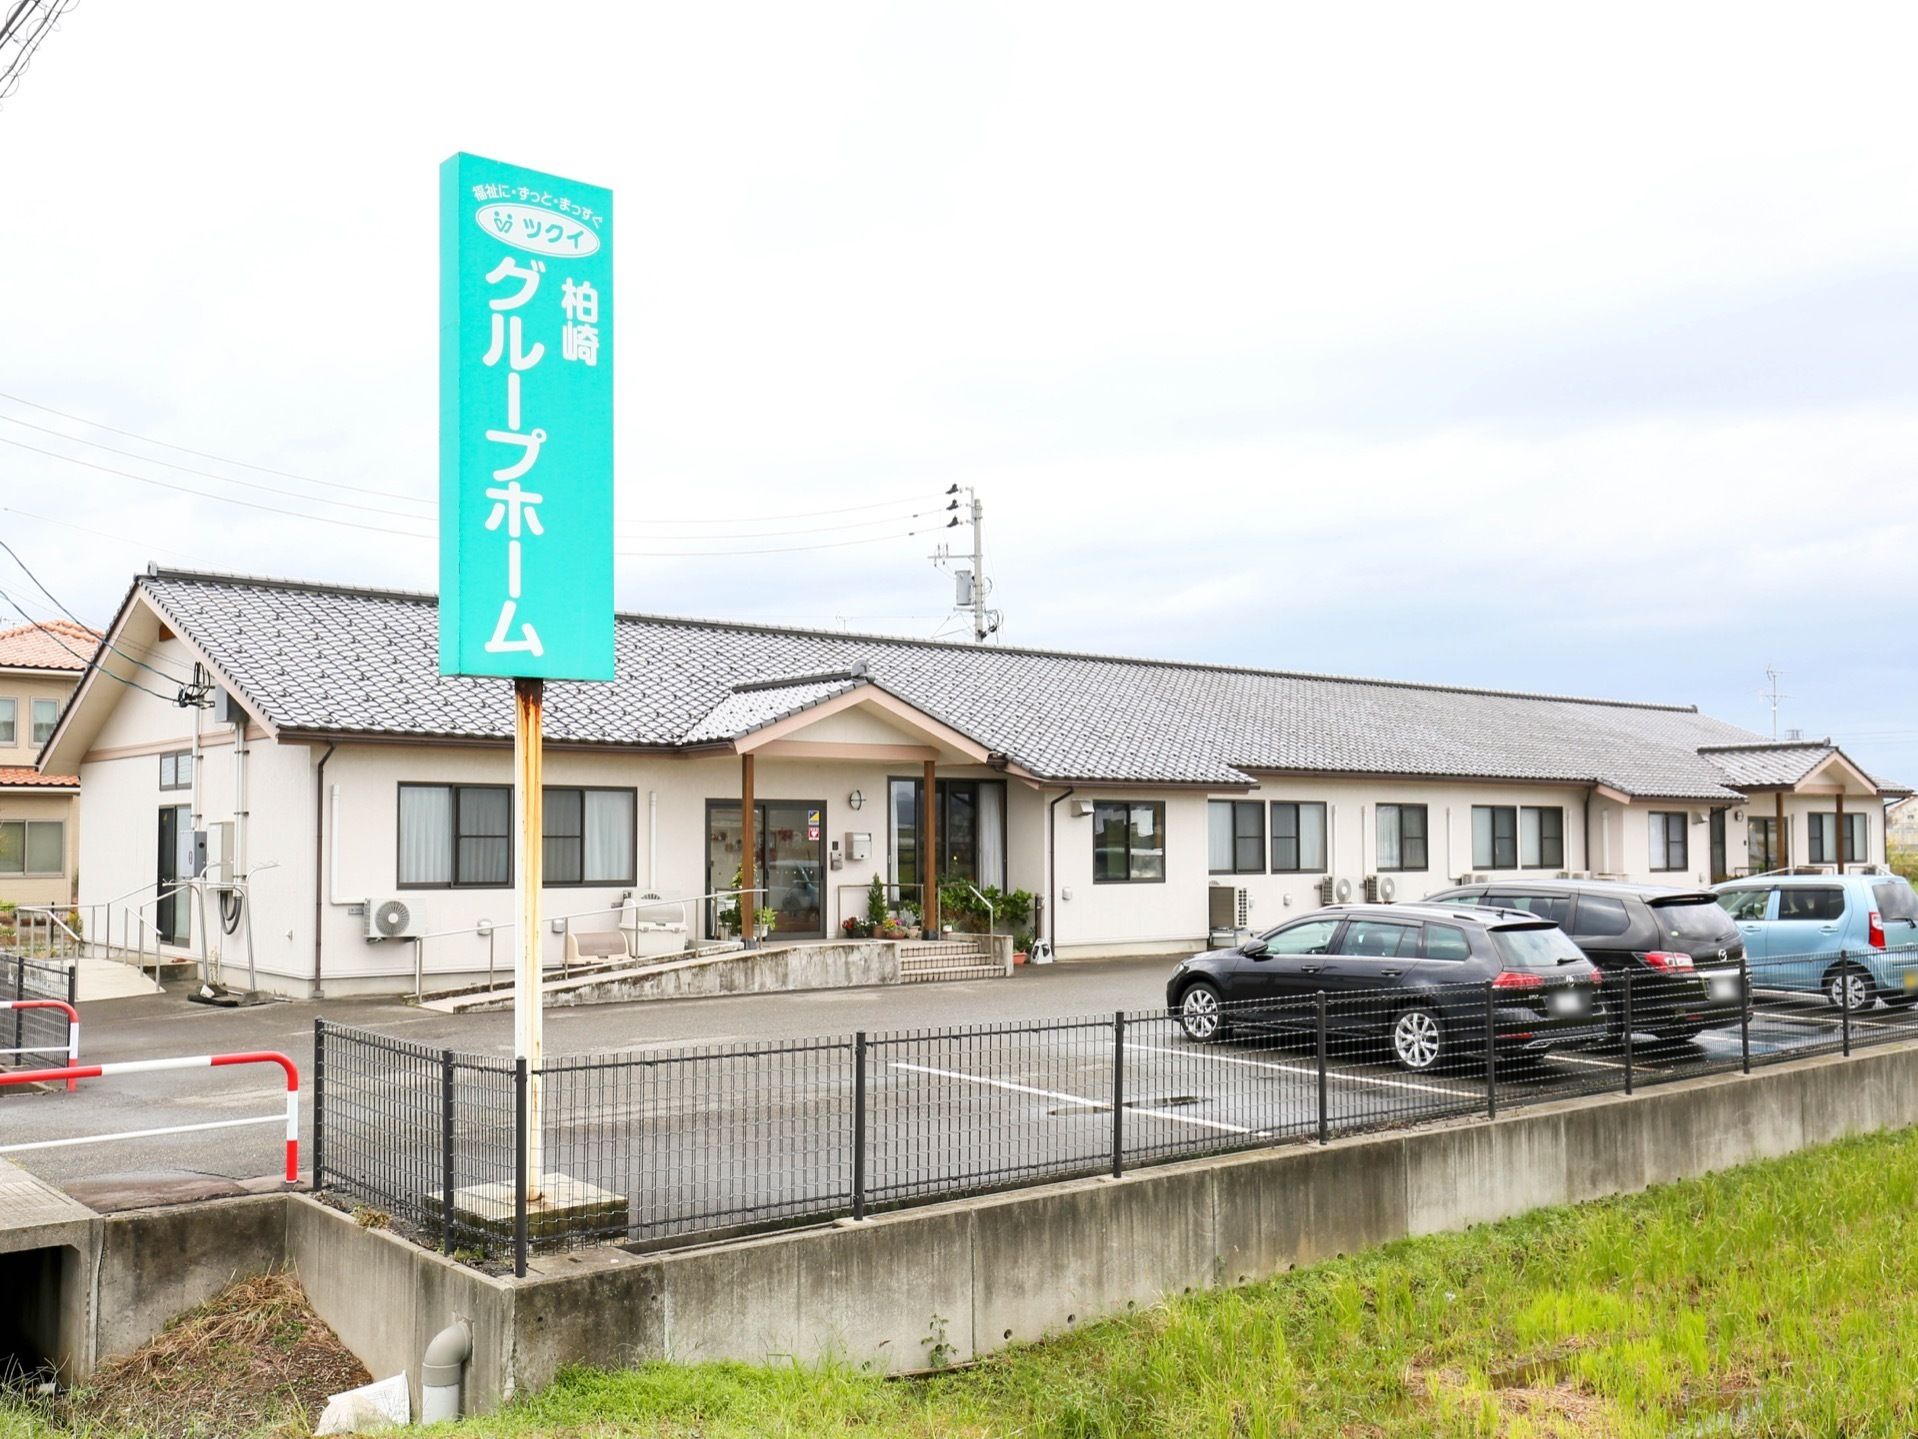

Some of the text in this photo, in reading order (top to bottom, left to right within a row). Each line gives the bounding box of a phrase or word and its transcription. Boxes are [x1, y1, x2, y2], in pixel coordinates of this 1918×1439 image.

[523, 218, 585, 249] ツクイ
[561, 277, 600, 367] 柏崎
[482, 256, 547, 657] グループホーム
